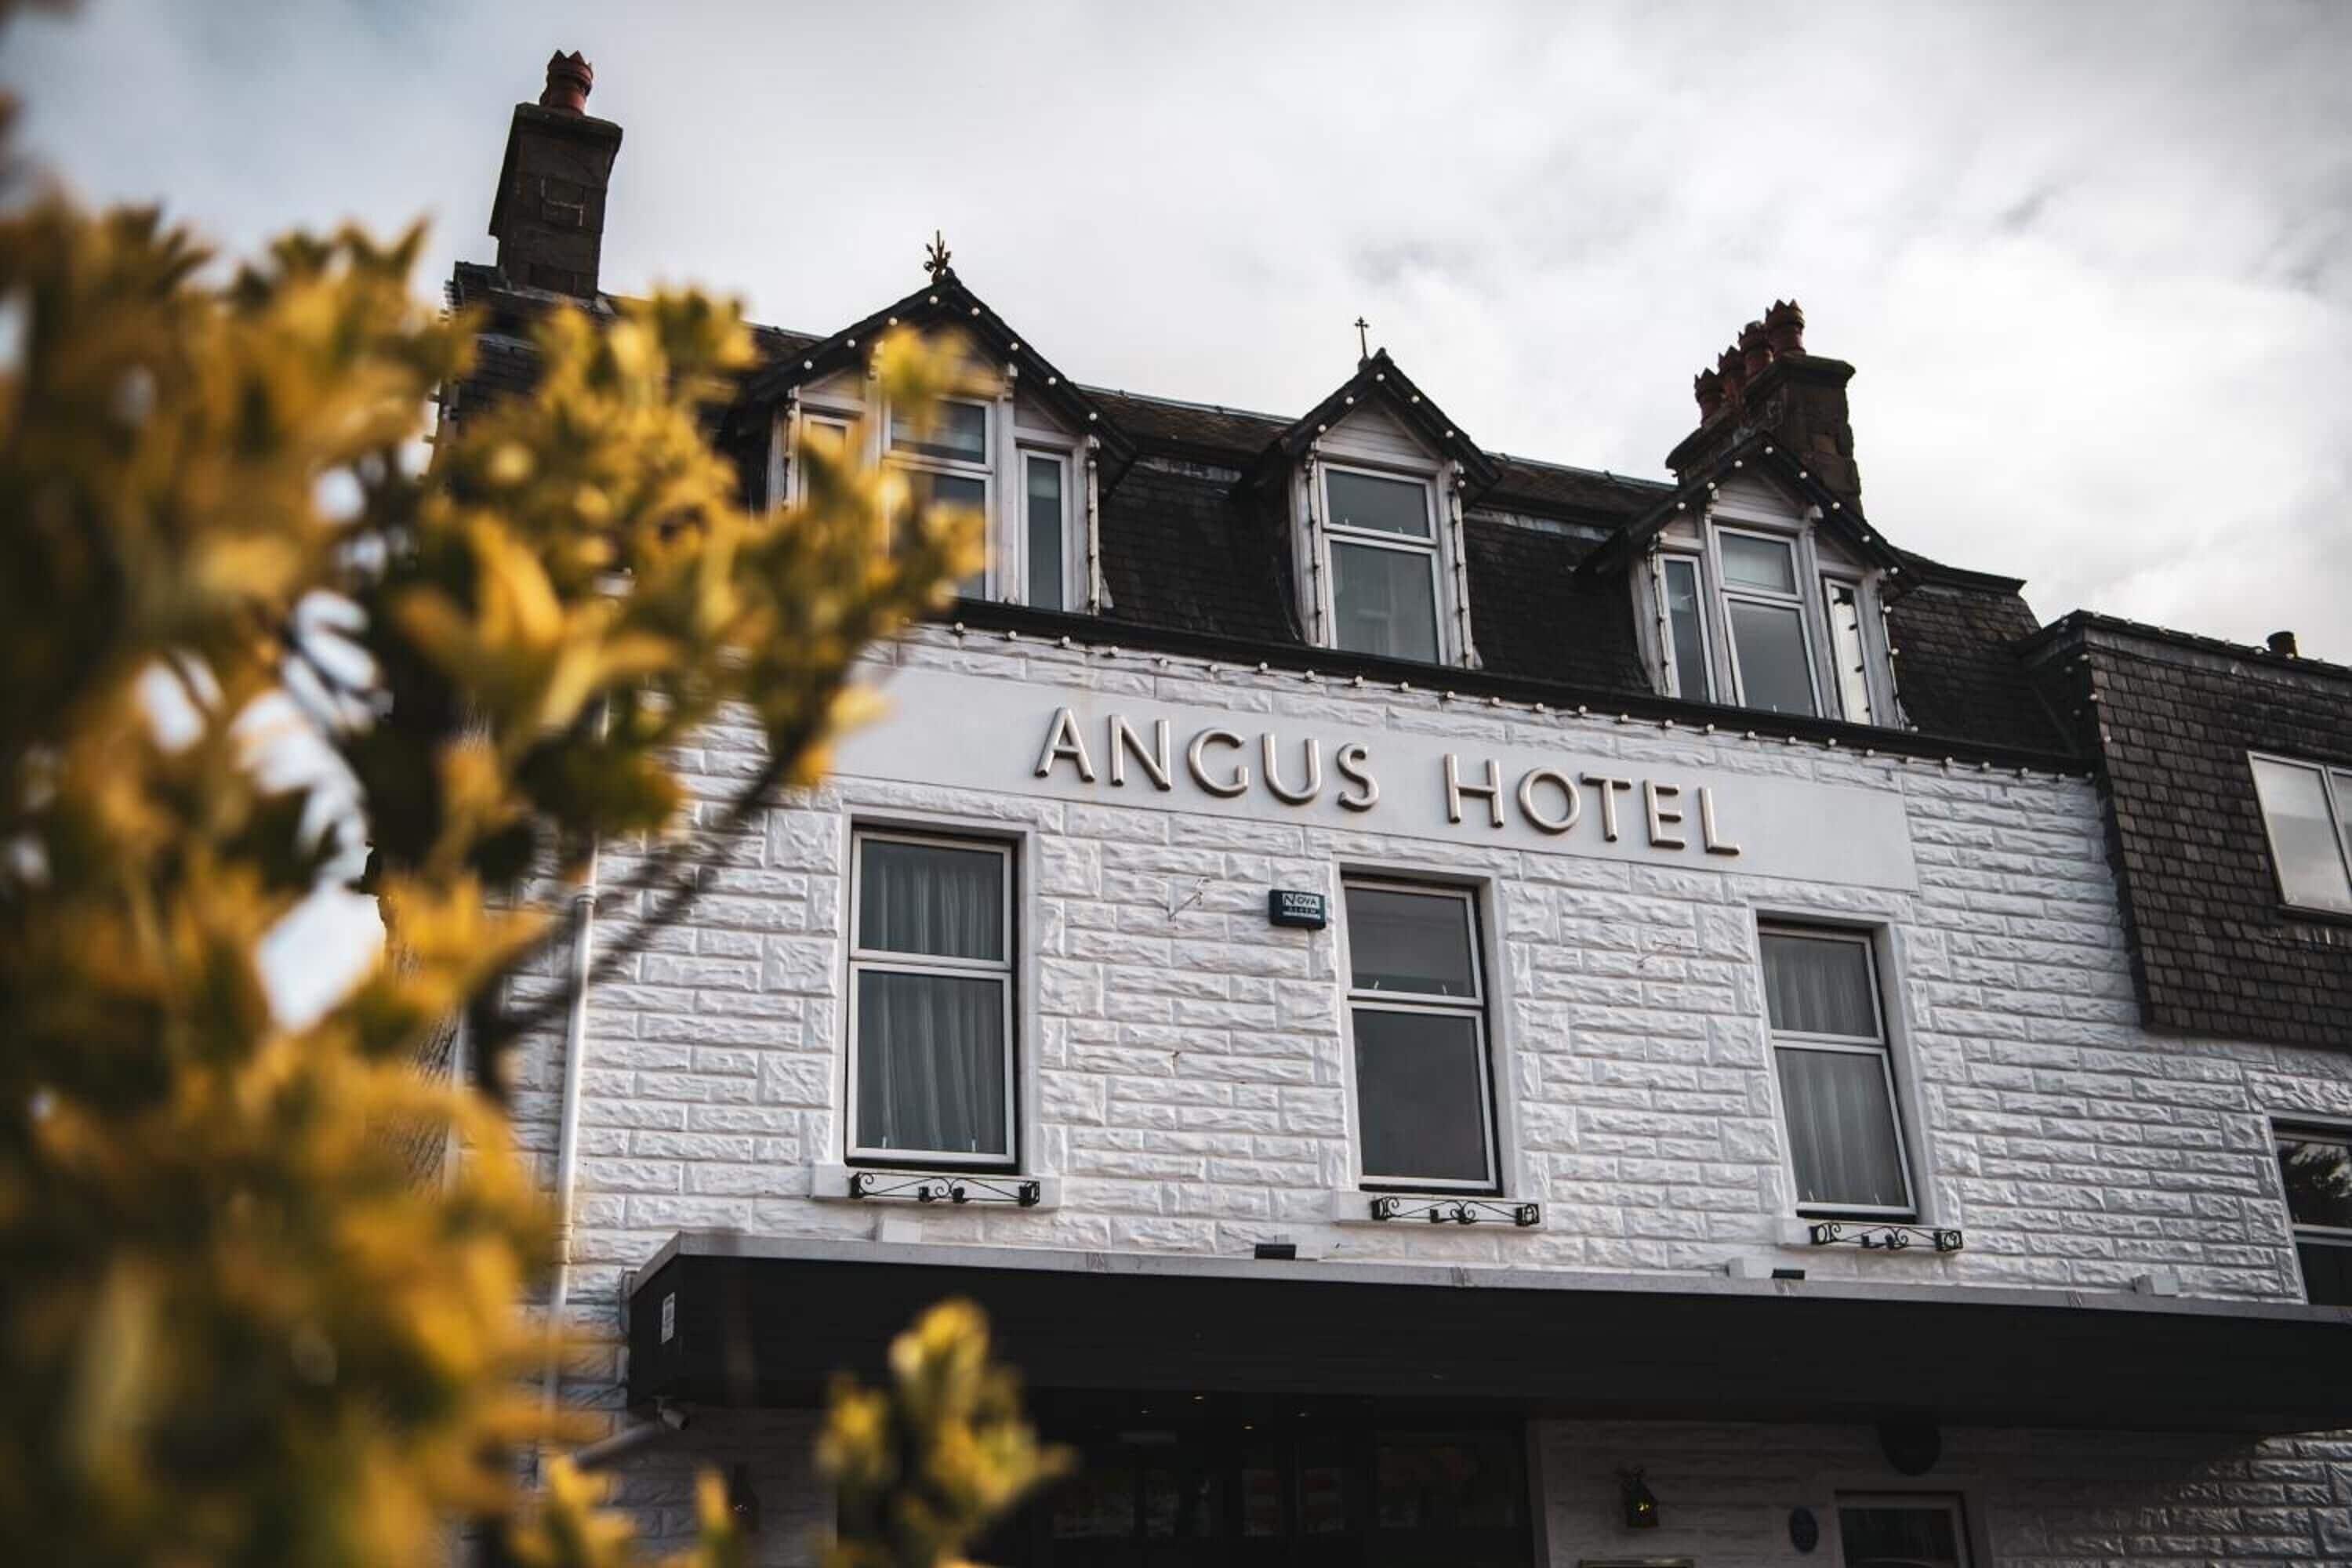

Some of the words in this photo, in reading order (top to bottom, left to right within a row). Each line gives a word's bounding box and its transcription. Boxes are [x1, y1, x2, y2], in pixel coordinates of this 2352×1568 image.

[1033, 706, 1380, 812] ANGUS
[1443, 752, 1740, 855] HOTEL
[1283, 895, 1317, 905] NOVA
